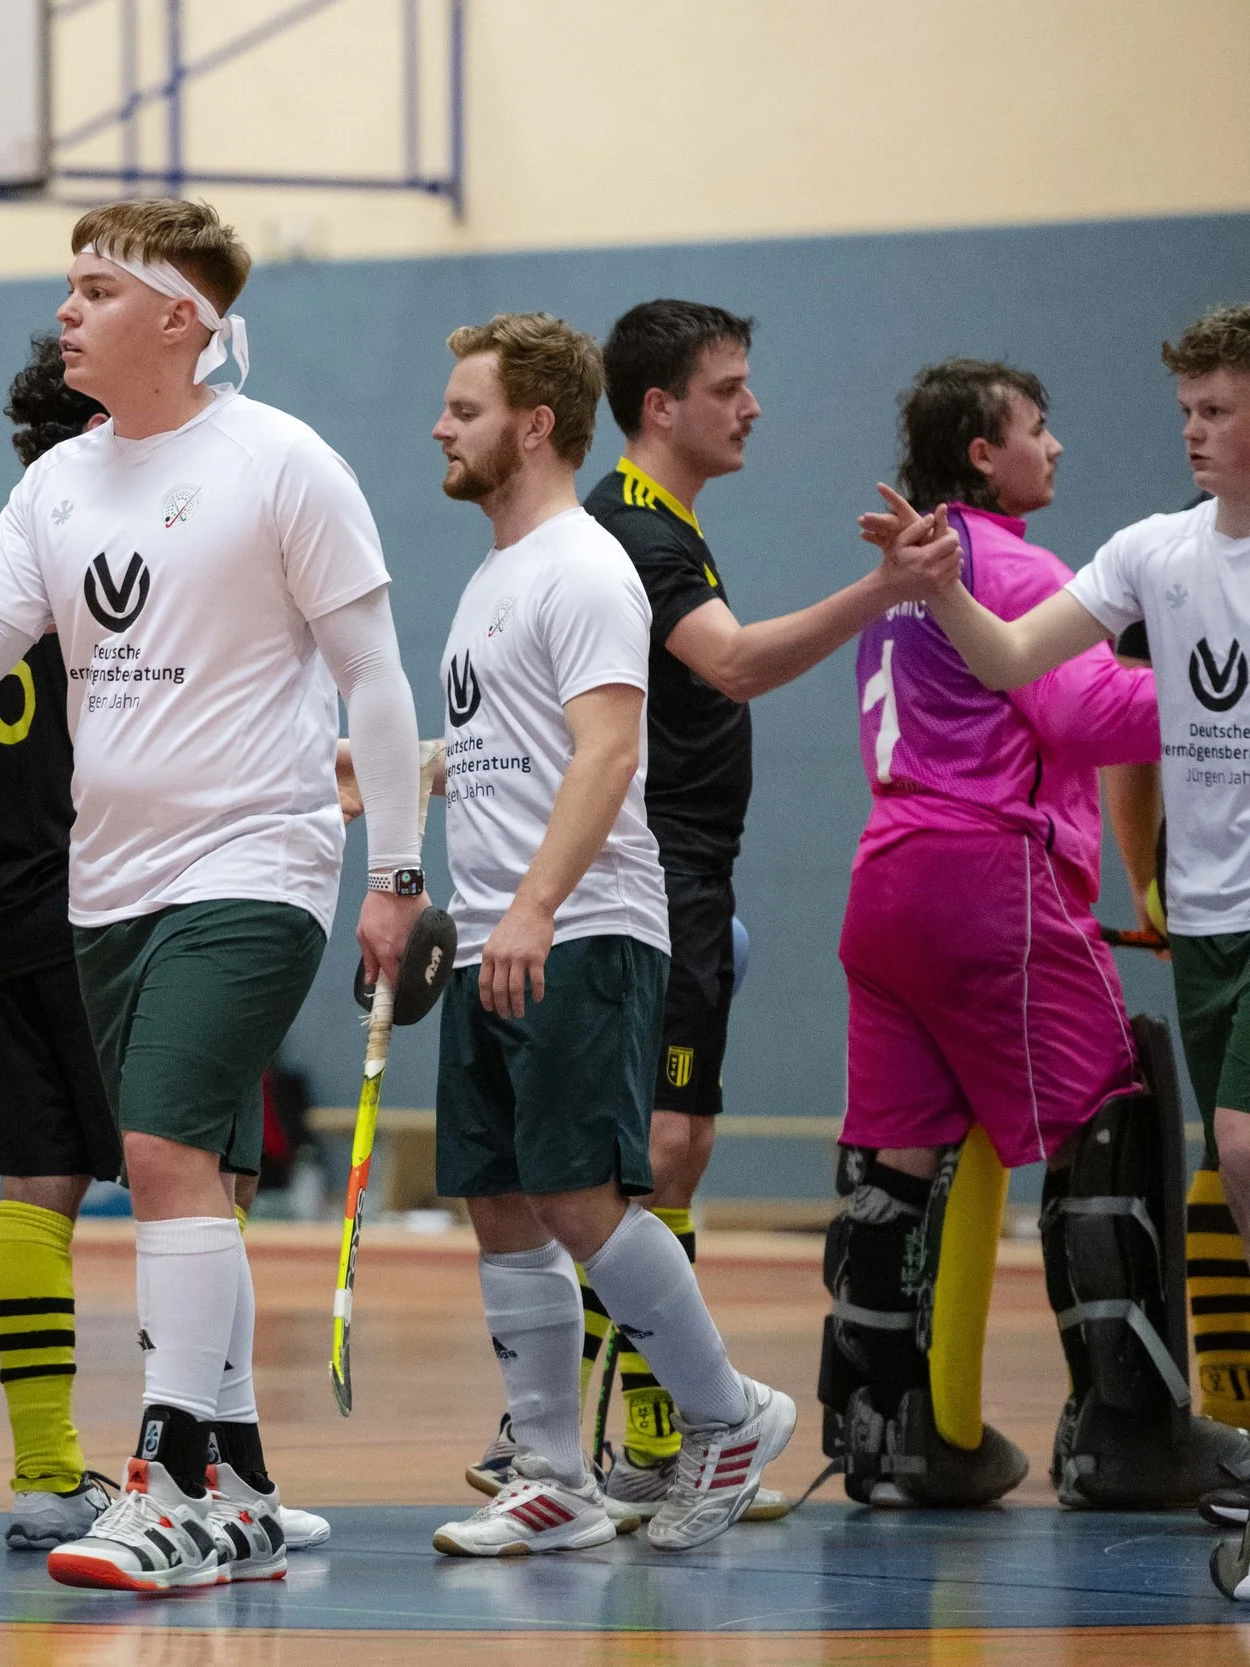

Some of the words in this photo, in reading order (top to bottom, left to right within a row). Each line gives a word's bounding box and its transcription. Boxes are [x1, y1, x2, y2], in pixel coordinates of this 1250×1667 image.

[862, 640, 901, 784] 1
[1189, 722, 1250, 739] Deutsche
[446, 736, 484, 758] eutsche
[1185, 767, 1226, 788] Jürgen
[1228, 770, 1250, 785] Jah
[462, 782, 496, 800] Jahn
